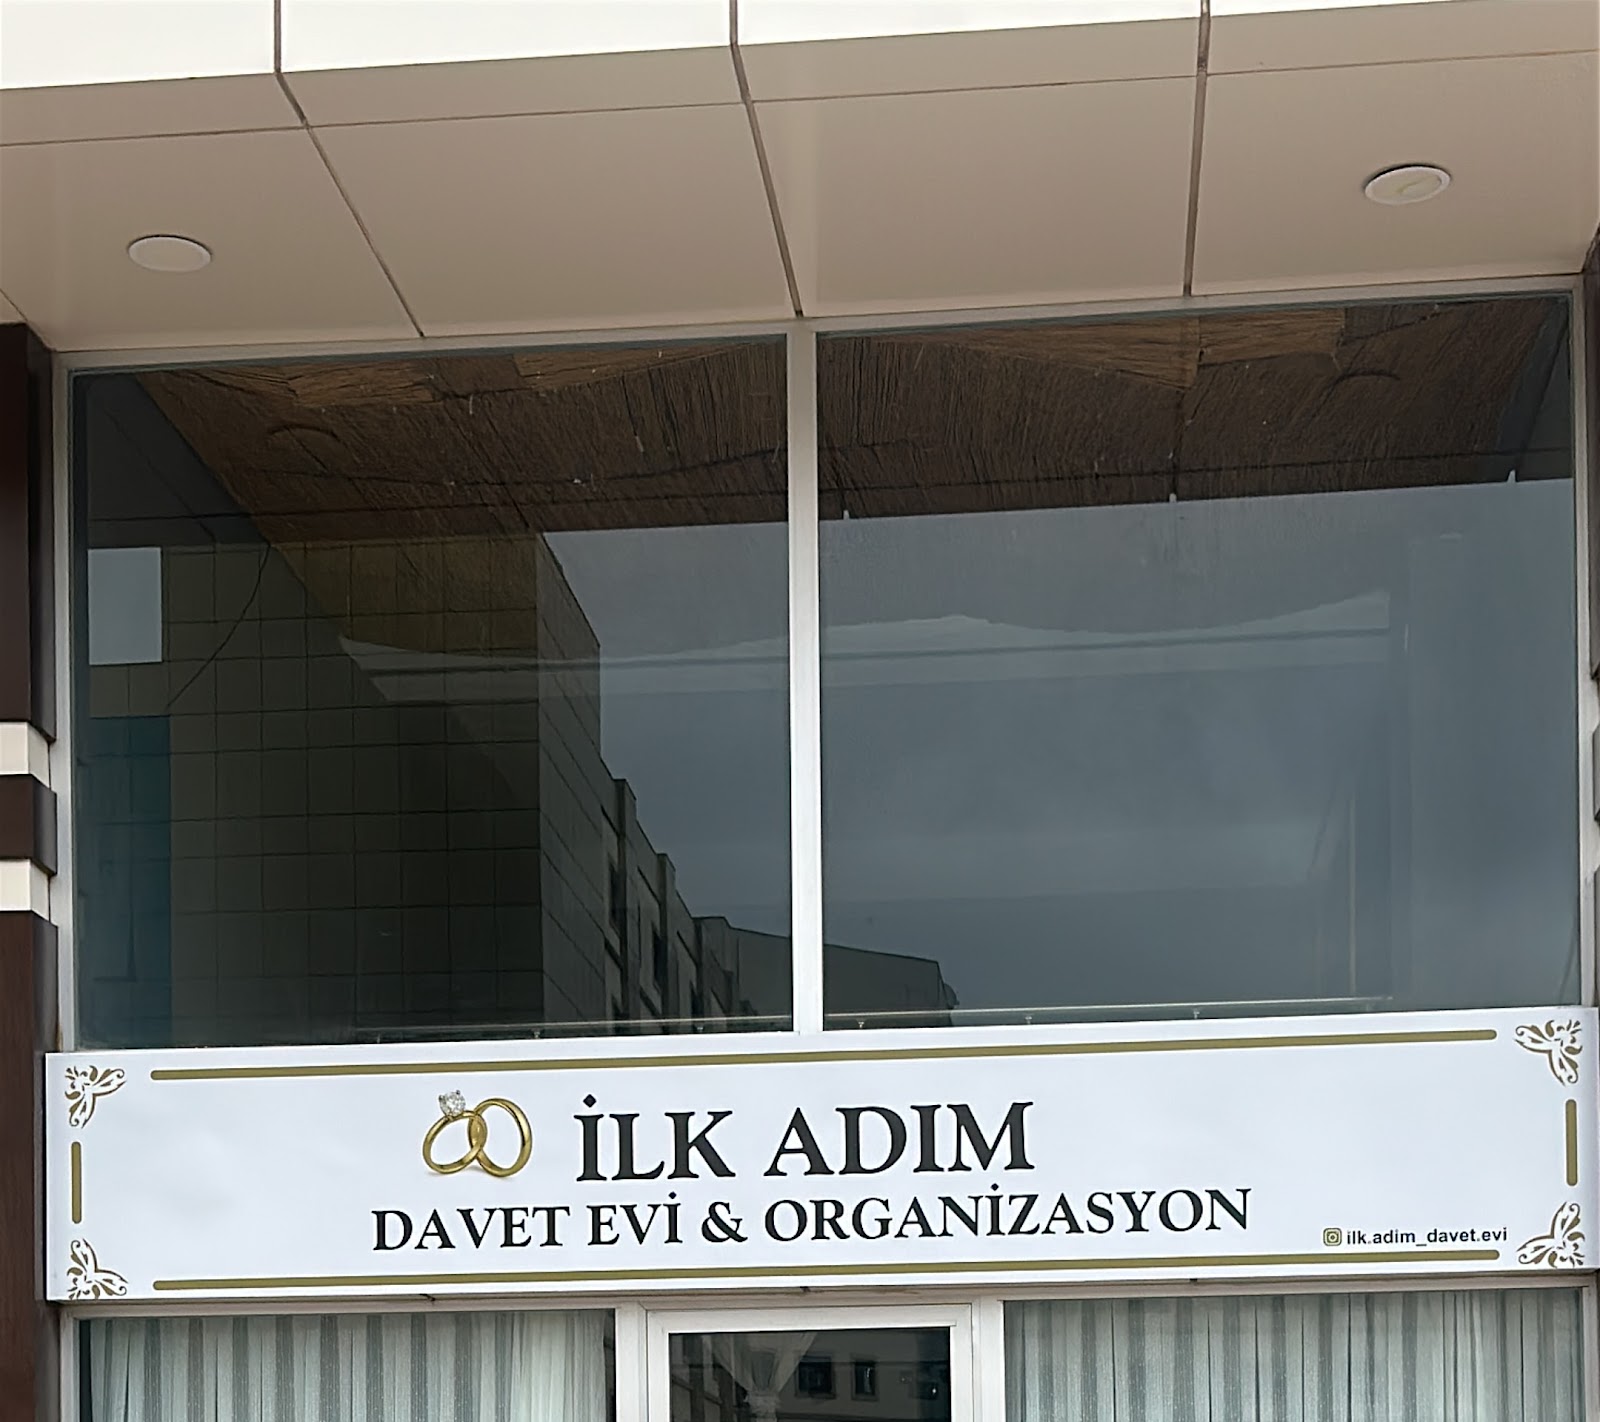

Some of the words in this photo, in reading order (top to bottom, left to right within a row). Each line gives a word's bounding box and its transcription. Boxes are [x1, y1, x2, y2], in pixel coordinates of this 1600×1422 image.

[573, 1094, 737, 1182] İLK
[763, 1101, 1036, 1178] ADIM
[371, 1205, 571, 1251] DAVET
[585, 1191, 684, 1246] EVİ
[701, 1201, 749, 1243] &
[764, 1182, 1252, 1242] ORGANİZASYON
[1346, 1226, 1508, 1247] ilk.adim_davet.evi
